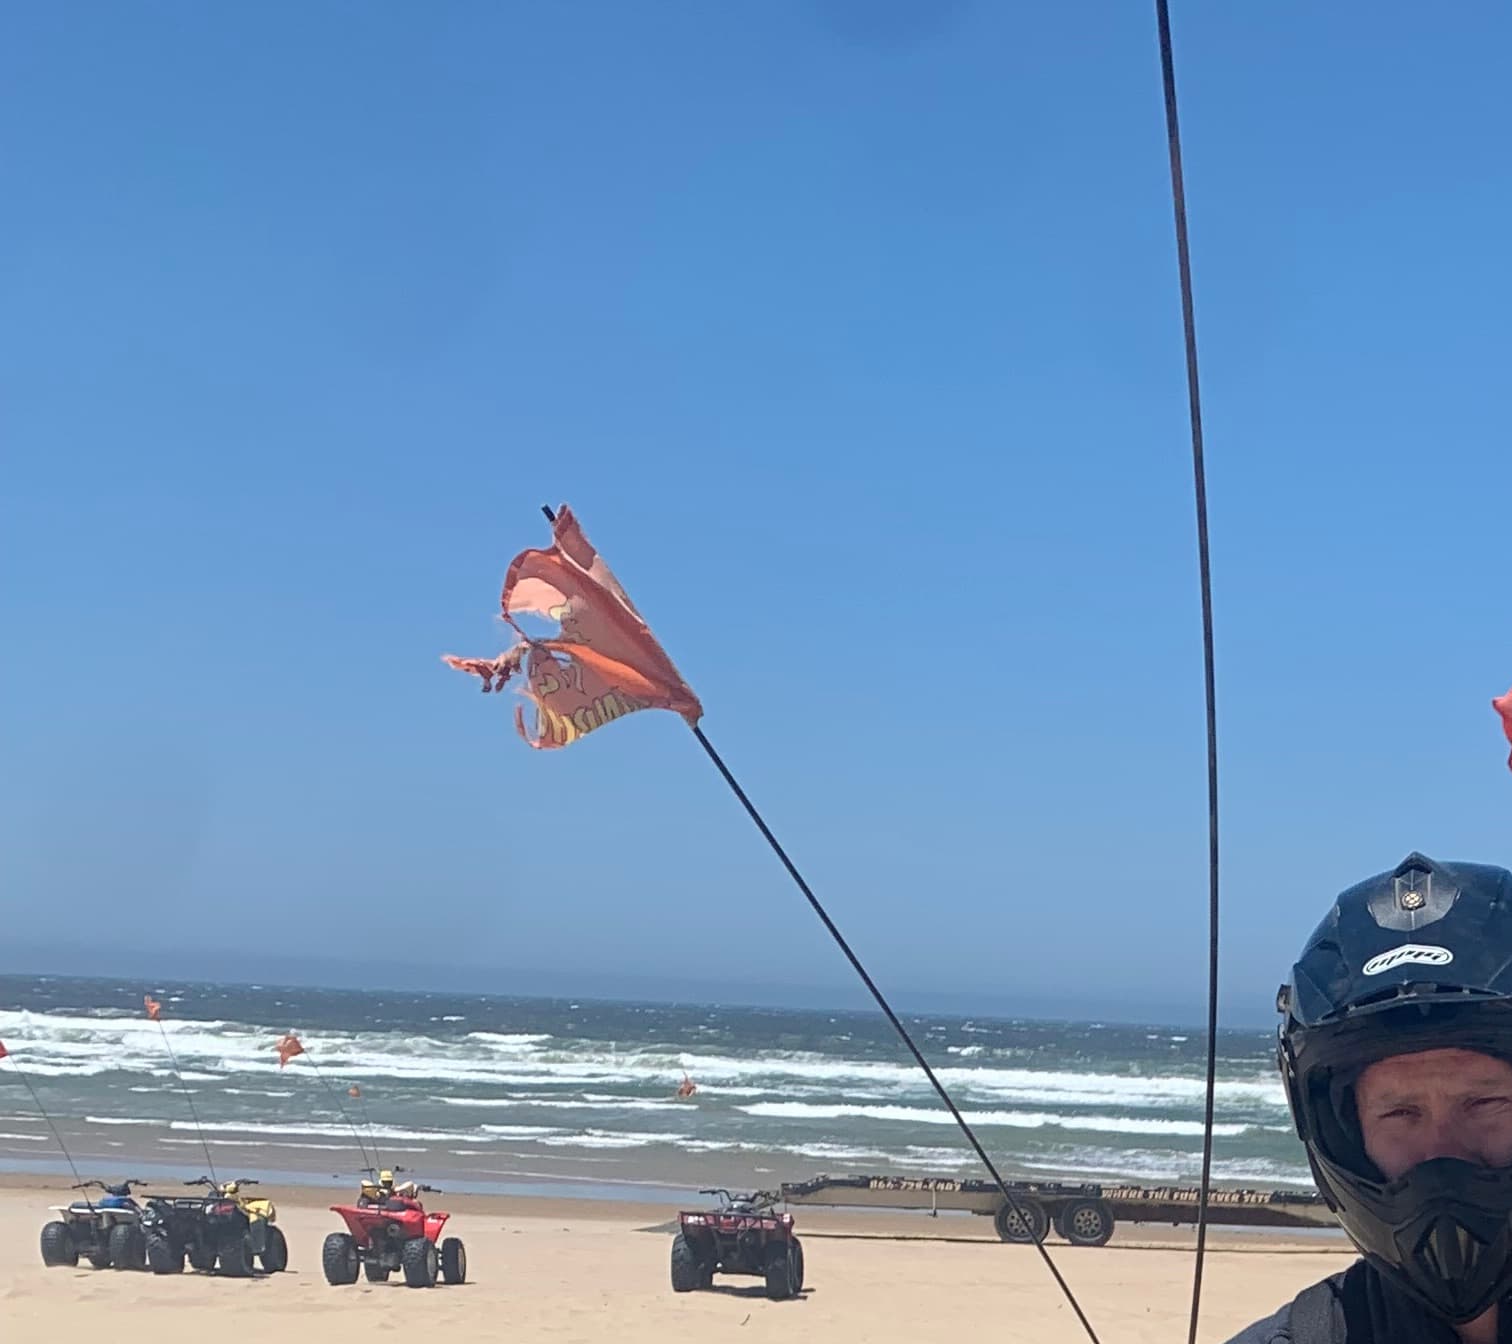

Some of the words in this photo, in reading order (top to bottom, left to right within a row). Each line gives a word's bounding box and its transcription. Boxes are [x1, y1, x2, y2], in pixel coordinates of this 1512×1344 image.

[1101, 1188, 1144, 1200] WHERE
[1147, 1189, 1170, 1201] THE
[1207, 1191, 1241, 1203] EVER
